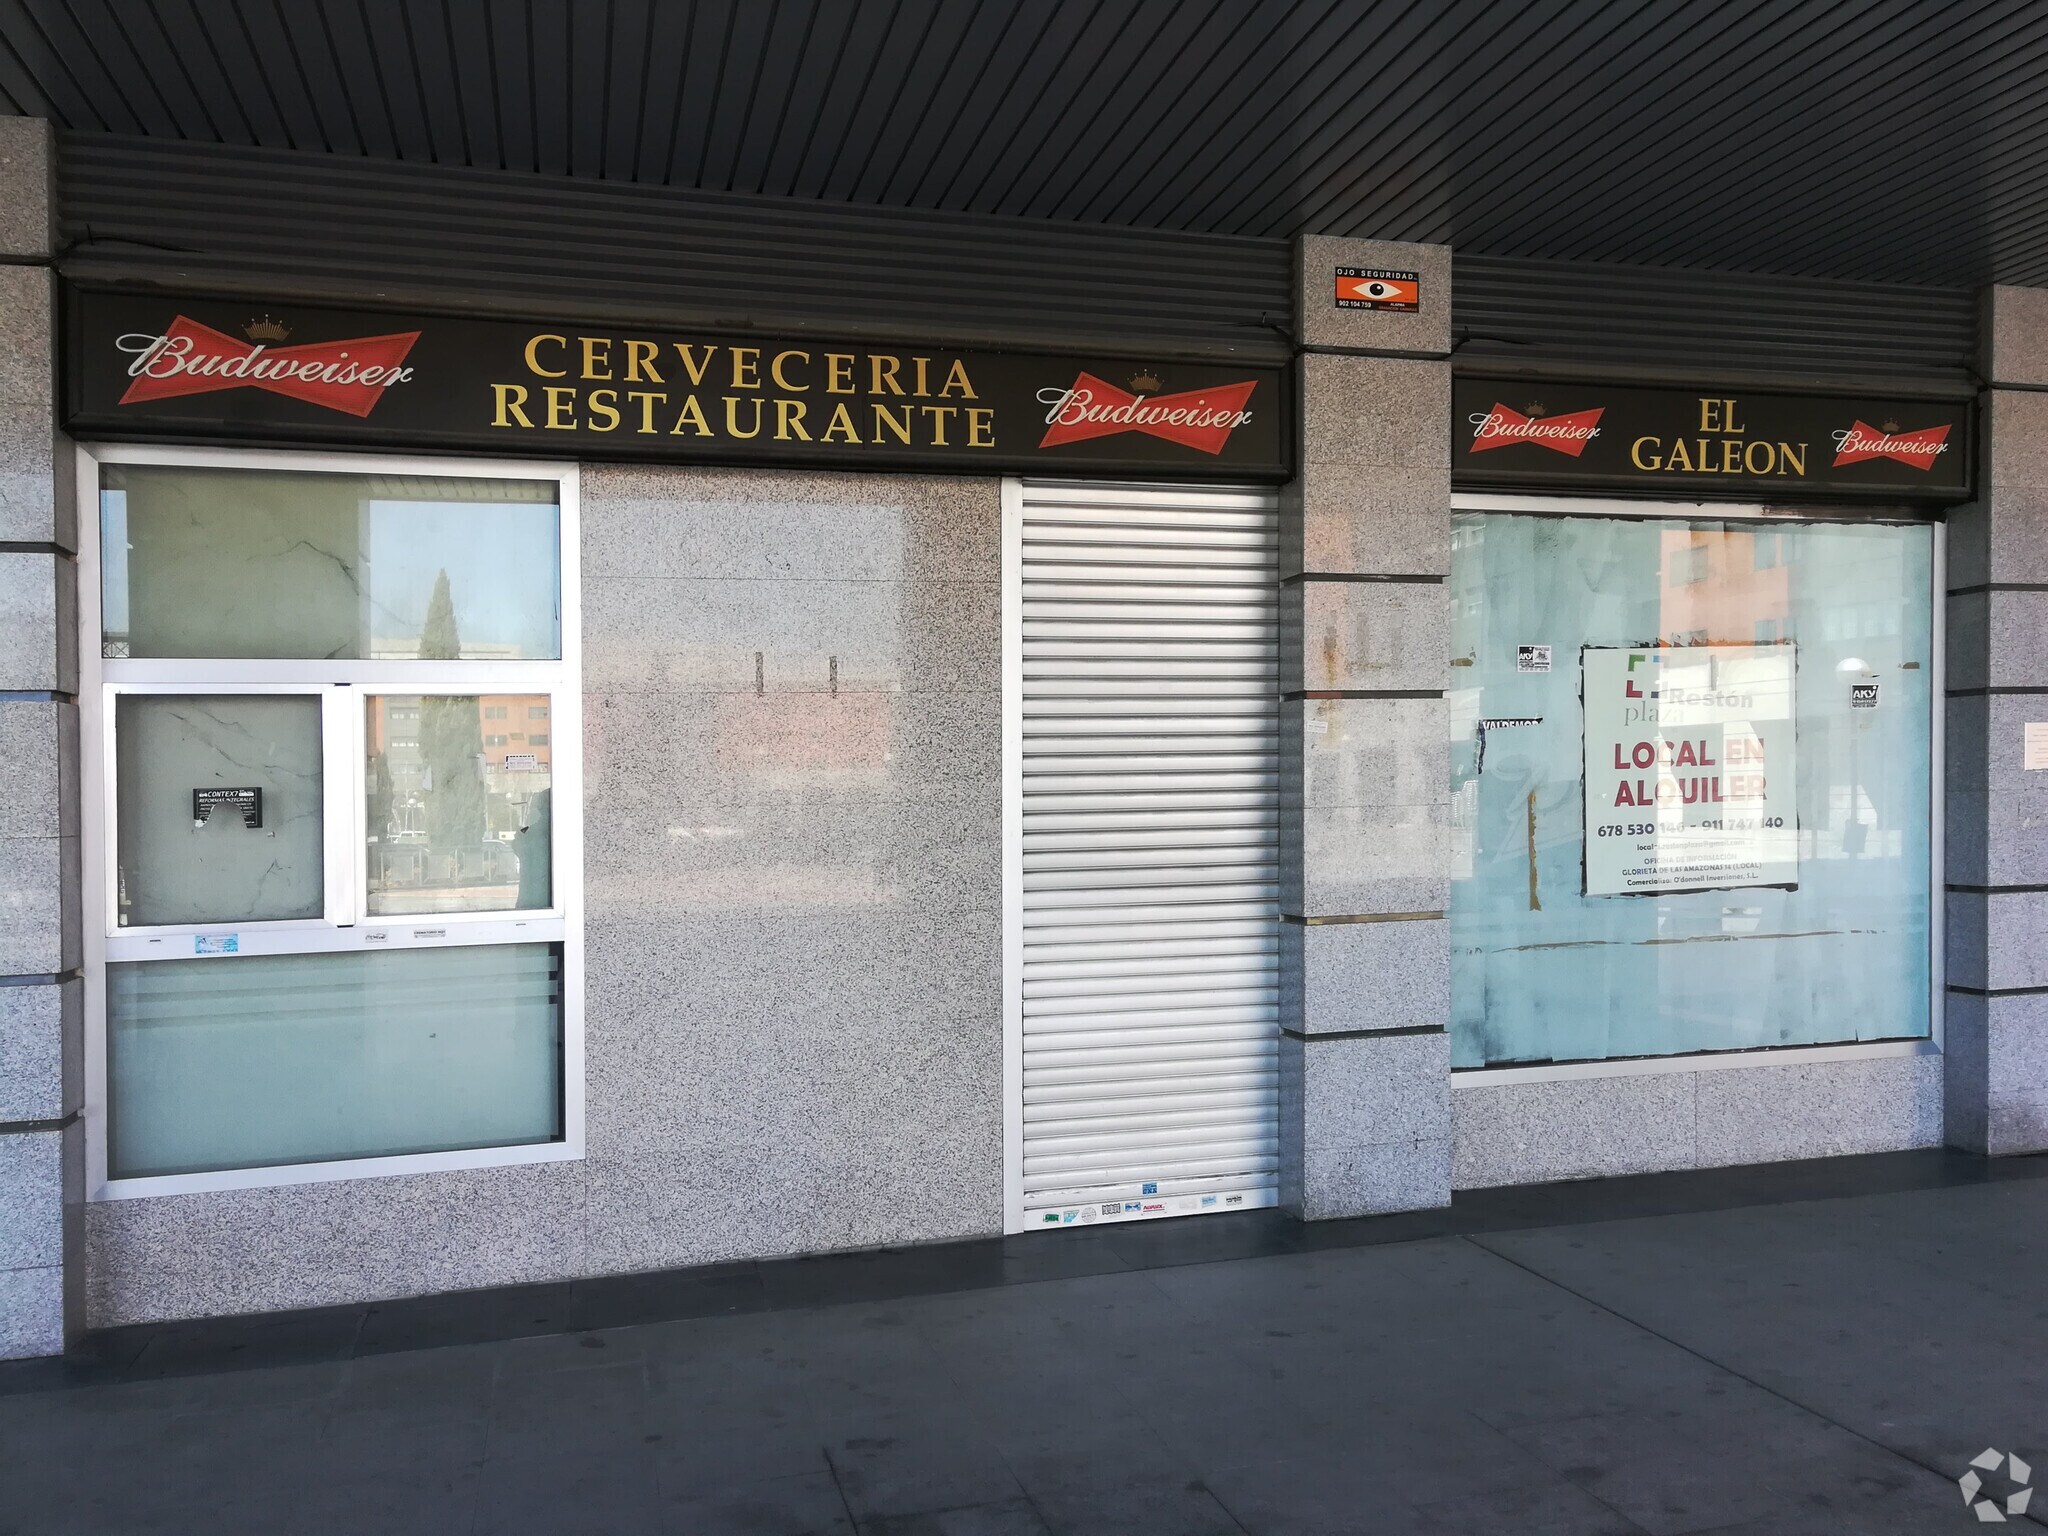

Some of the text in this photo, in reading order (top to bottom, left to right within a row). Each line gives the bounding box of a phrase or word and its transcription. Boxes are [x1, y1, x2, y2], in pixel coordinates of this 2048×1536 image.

[1337, 268, 1414, 280] OJO SEGURIDAD
[116, 333, 414, 388] Budweiser
[524, 334, 979, 400] CERVECERIA
[490, 383, 995, 448] RESTAURANTE
[1036, 387, 1253, 428] Budweiser
[1698, 398, 1745, 433] EL
[1468, 412, 1602, 440] Budweiser
[1631, 436, 1808, 476] GALEON
[1831, 429, 1950, 456] Budweiser
[1668, 687, 1753, 708] Restón
[1624, 700, 1684, 726] plaza
[1614, 738, 1764, 769] LOCAL EN
[1614, 775, 1767, 807] ALQUILER
[1597, 825, 1623, 837] 678
[1627, 823, 1655, 836] 530
[1702, 819, 1723, 831] 911
[1622, 868, 1658, 876] GLORIETA
[1659, 867, 1669, 875] DE
[1670, 866, 1683, 874] LAS
[1683, 864, 1723, 872] AMAZONAS
[1732, 862, 1762, 871] (LOCAL)
[1644, 857, 1674, 865] OFICINA
[1676, 856, 1685, 864] DE
